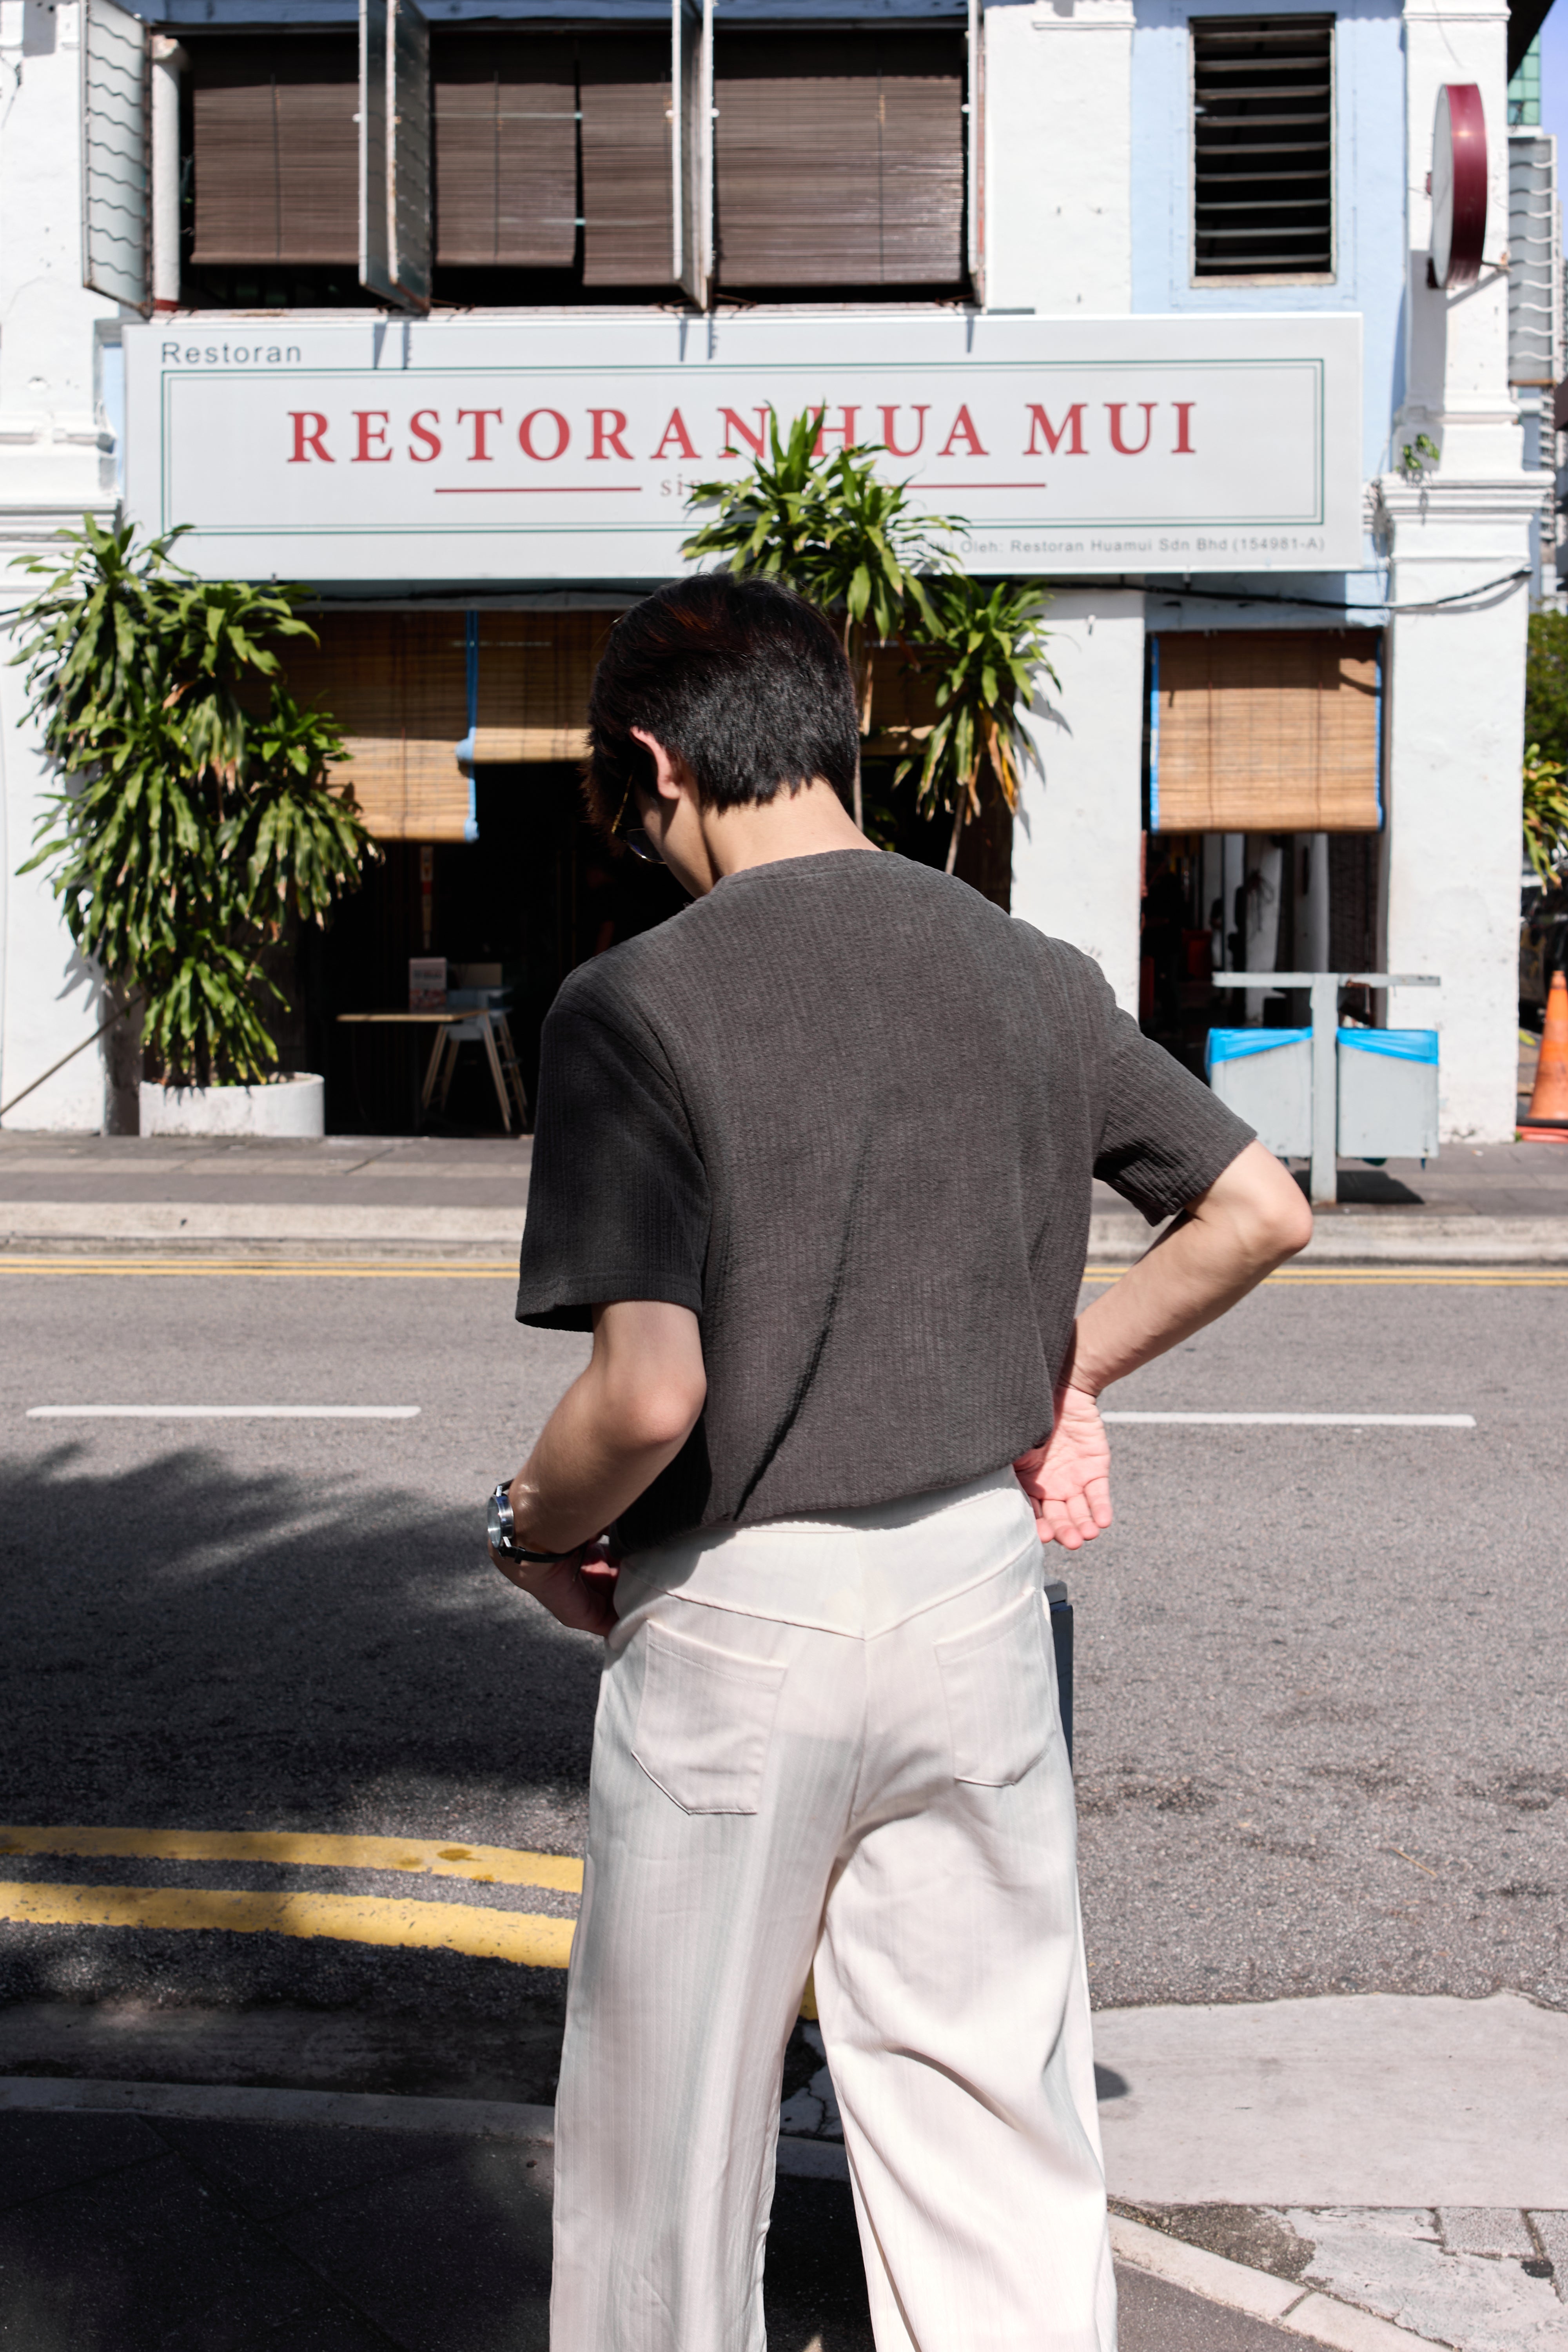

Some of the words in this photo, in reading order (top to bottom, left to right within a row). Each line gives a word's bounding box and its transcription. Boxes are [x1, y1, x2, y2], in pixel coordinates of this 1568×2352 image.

[160, 341, 301, 364] Restoran
[288, 407, 771, 463] RESTORAN
[808, 404, 989, 457] HUA
[1024, 402, 1195, 456] MUI
[961, 539, 1003, 553] Oleh:
[1010, 539, 1084, 553] Restoran
[1090, 539, 1152, 552] Huamui
[1158, 537, 1190, 552] Sdn
[1196, 537, 1228, 552] Bhd
